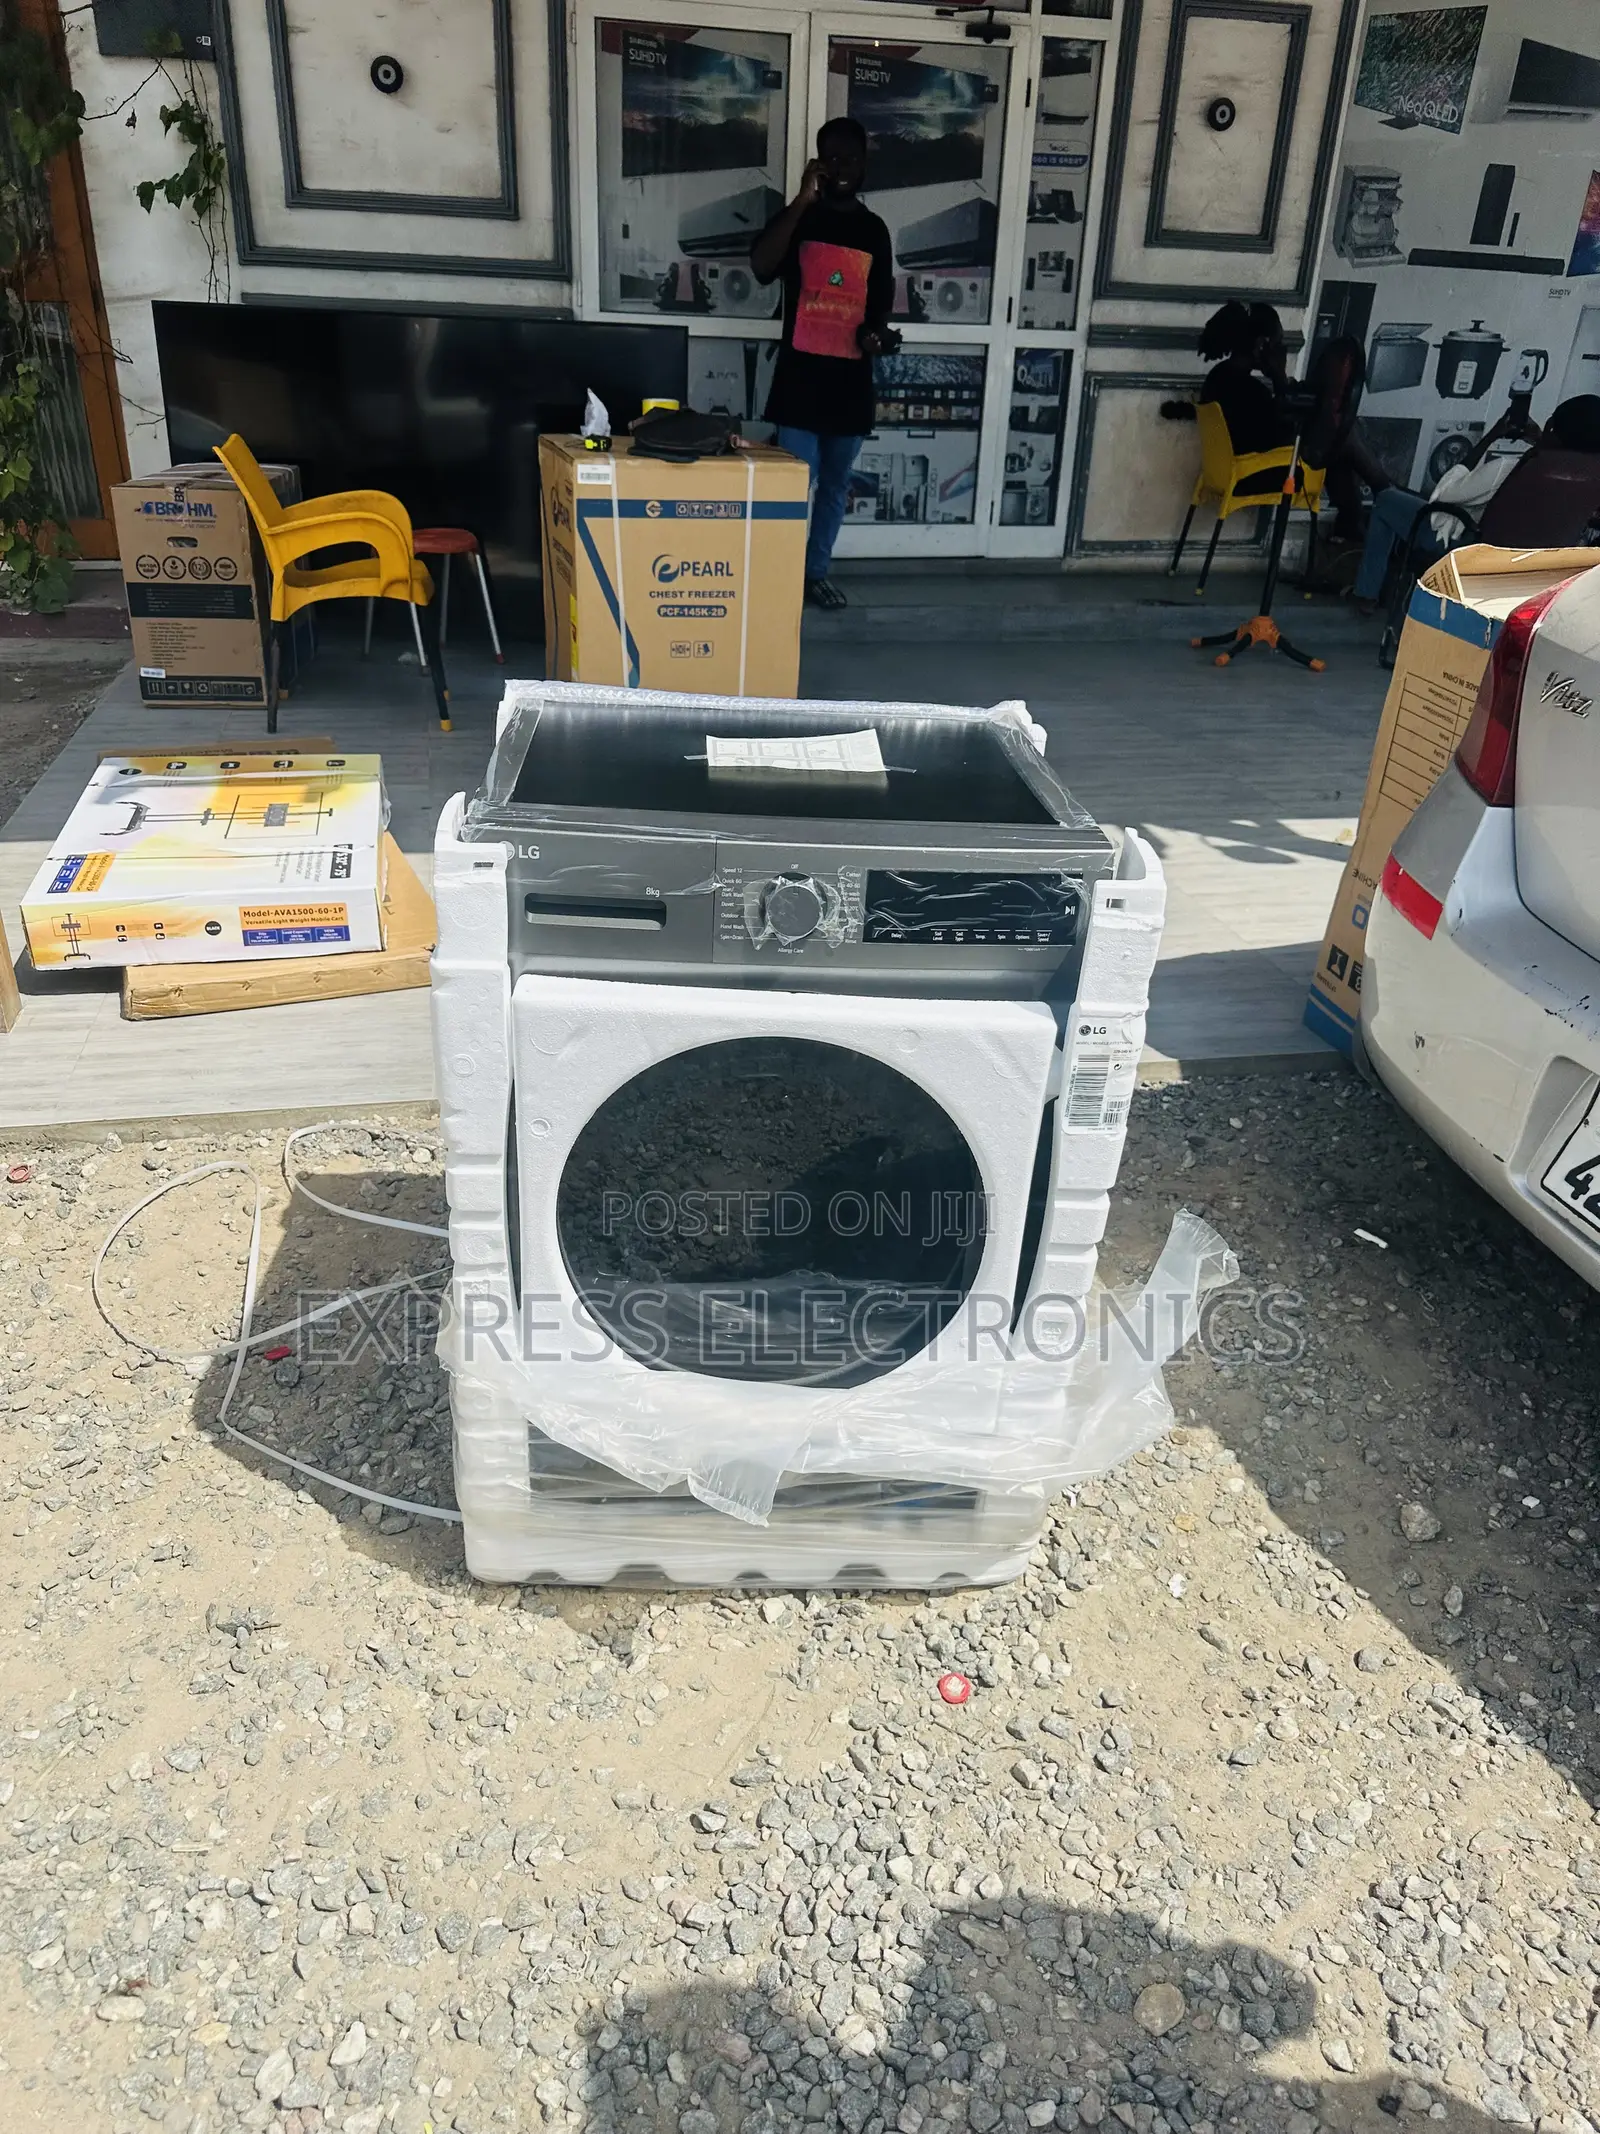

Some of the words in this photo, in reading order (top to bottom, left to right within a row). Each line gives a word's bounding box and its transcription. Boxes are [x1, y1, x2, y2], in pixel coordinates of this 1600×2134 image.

[1399, 96, 1421, 119] Neo
[1423, 100, 1458, 124] QLED
[680, 561, 734, 577] PEARL
[649, 590, 685, 599] CHEST
[688, 590, 736, 599] FREEZER
[659, 607, 725, 617] PCF-145K-2B
[1540, 671, 1593, 719] Vitz
[518, 845, 540, 860] LG
[1351, 867, 1378, 890] ACHINE
[645, 886, 660, 897] 8kg
[243, 906, 344, 918] Model-AVA1500-60-1P
[1093, 1026, 1107, 1035] LG
